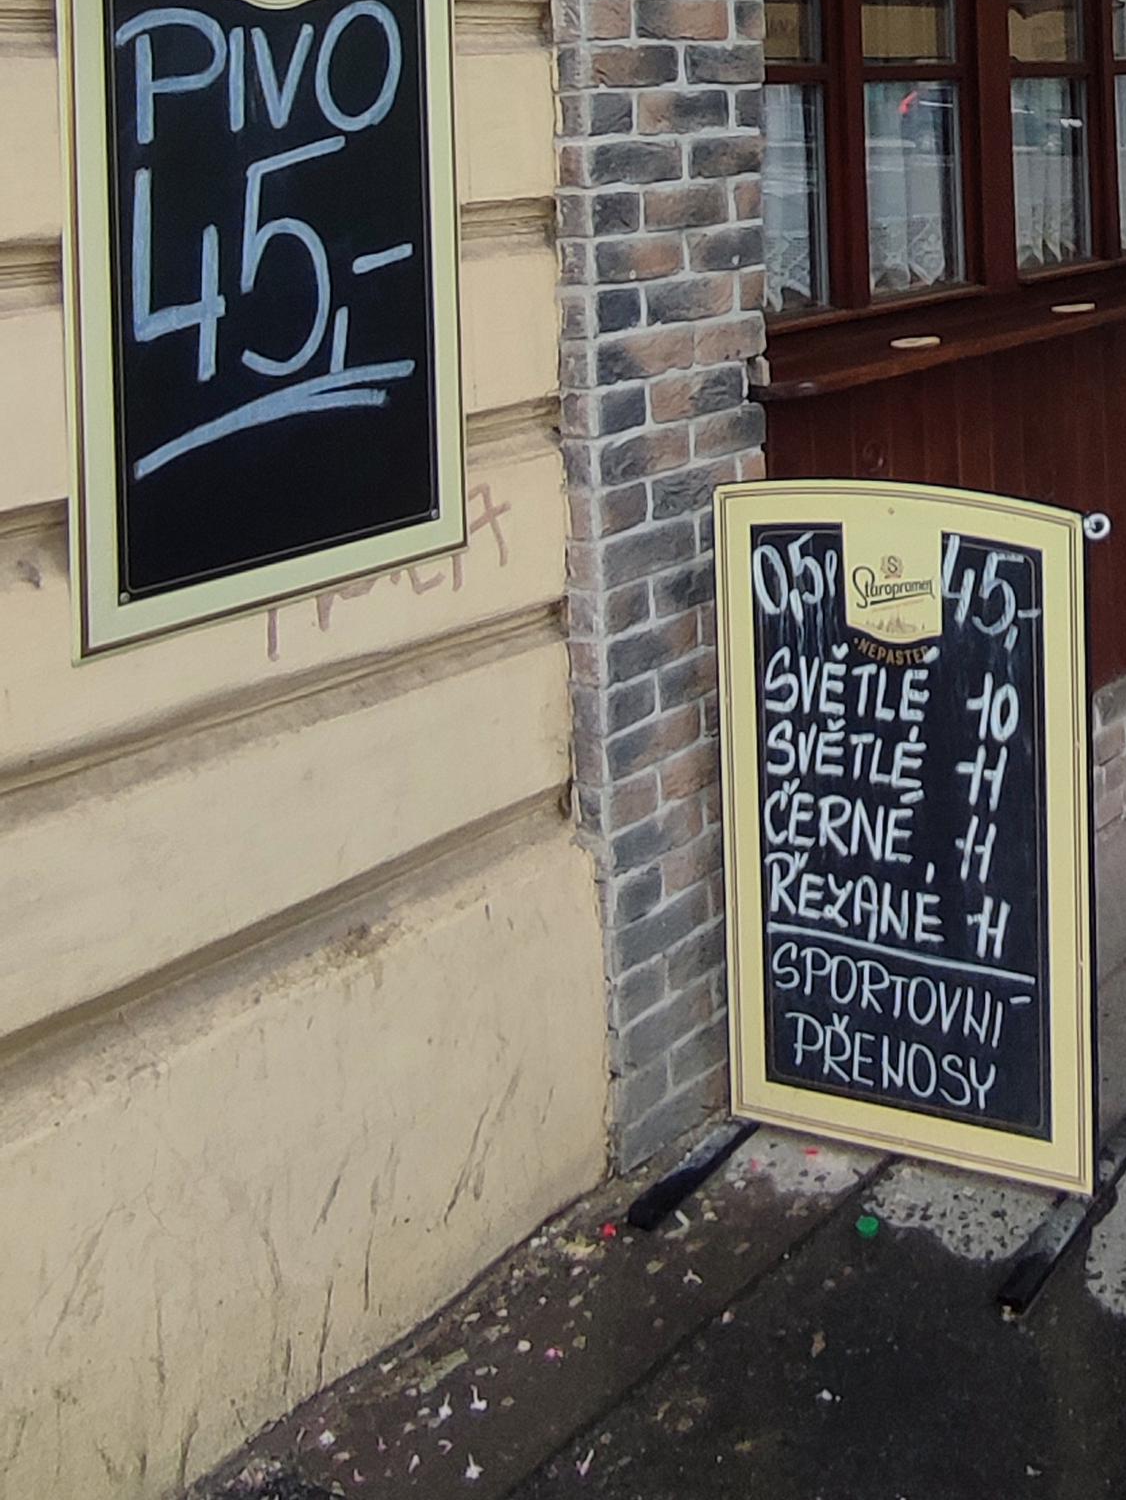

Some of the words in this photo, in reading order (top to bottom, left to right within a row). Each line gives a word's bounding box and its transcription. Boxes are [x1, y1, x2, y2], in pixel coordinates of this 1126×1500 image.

[115, 0, 401, 145] PIVO
[852, 566, 935, 609] Staropramen
[765, 643, 940, 722] SVĚTLÉ
[767, 719, 927, 789] SVĚTLÉ
[764, 778, 925, 864] ČERNÉ
[773, 942, 1031, 1048] SPORTOVNÍ
[785, 1013, 996, 1109] PŘENOSY
